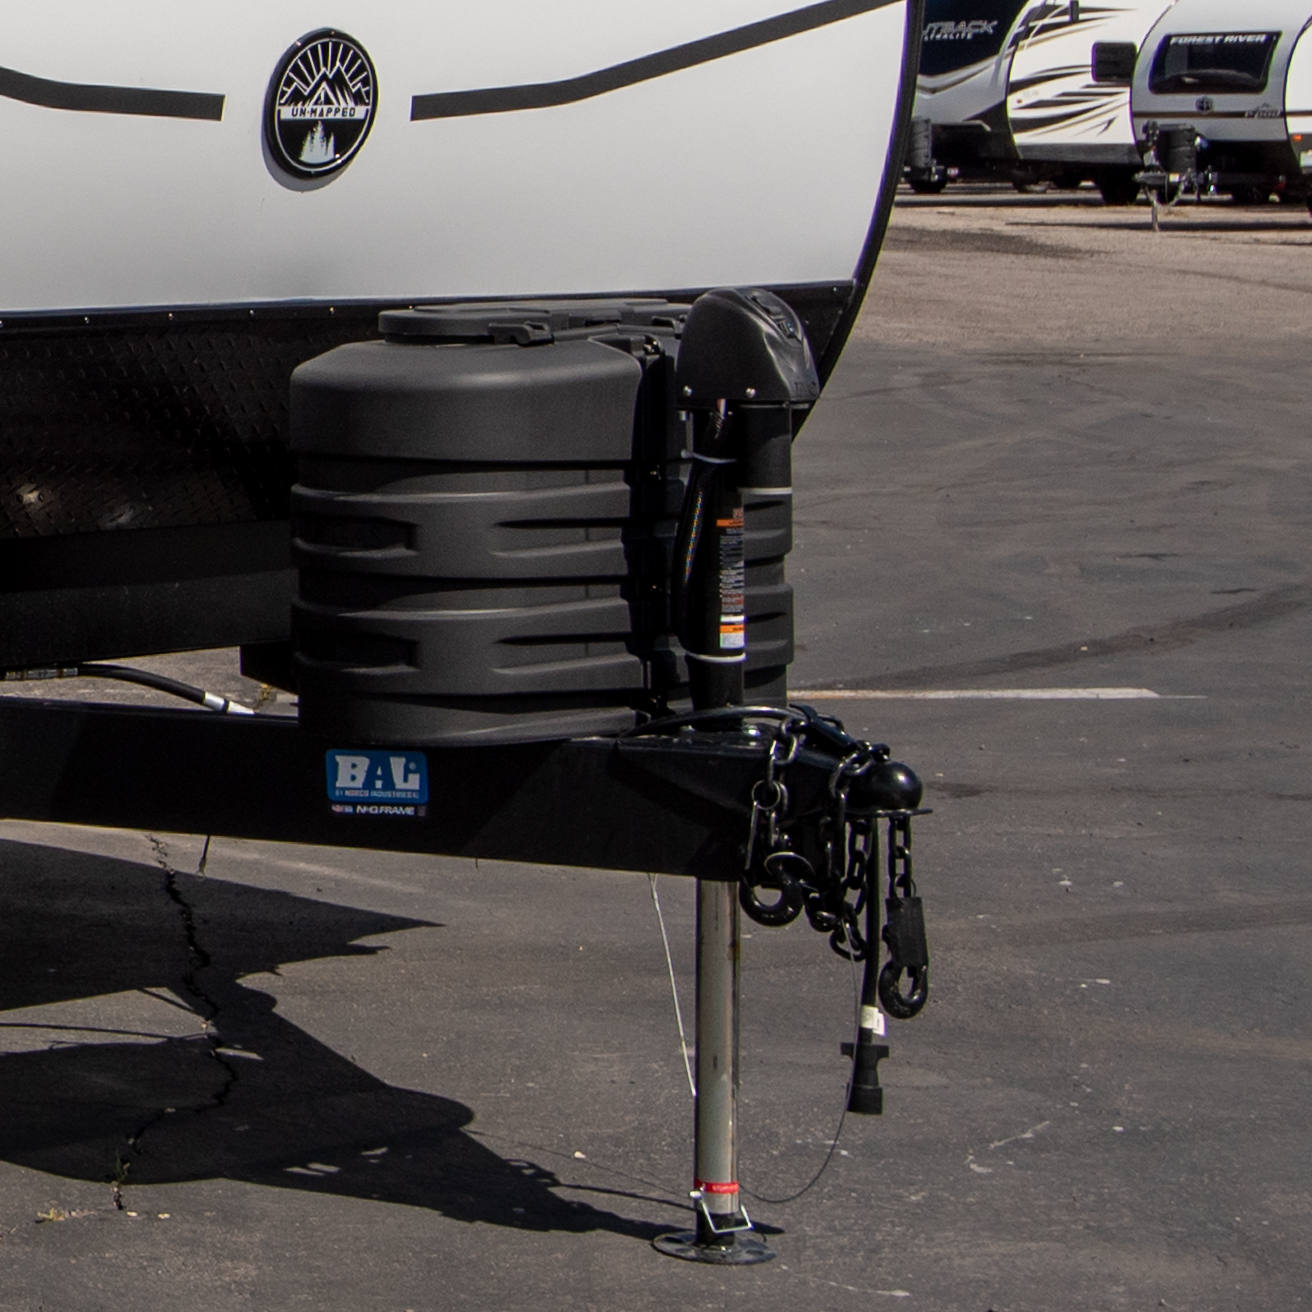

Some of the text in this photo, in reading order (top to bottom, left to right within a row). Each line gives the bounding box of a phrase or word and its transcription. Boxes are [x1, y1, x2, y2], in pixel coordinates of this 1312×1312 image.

[923, 20, 998, 34] TBACK
[1169, 33, 1267, 45] FOREST RIVER
